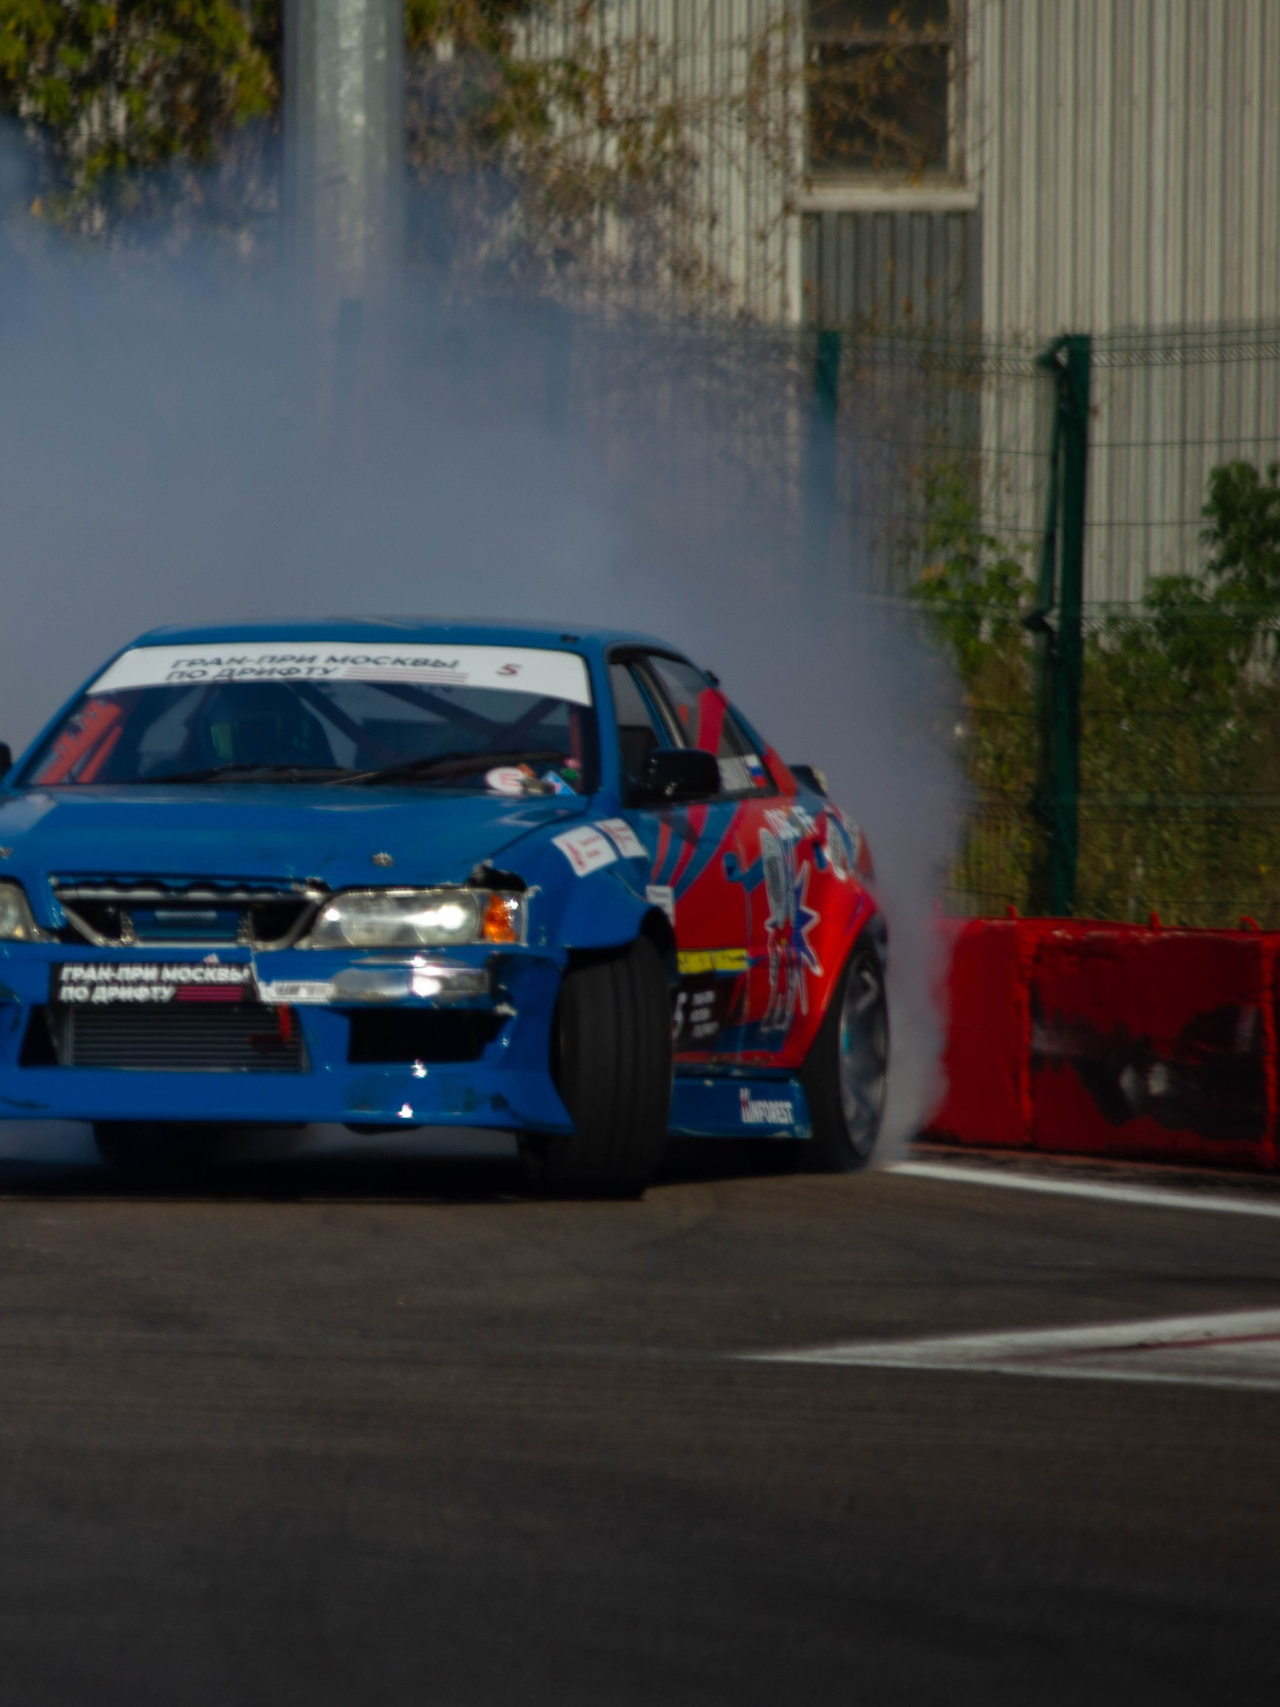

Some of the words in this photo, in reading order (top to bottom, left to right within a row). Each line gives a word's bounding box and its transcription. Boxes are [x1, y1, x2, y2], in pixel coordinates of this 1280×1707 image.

[172, 655, 317, 668] ГРАН-ПРИ
[325, 655, 460, 669] МОСКВЫ
[166, 669, 208, 681] ПО
[214, 667, 338, 682] ДРИФТУ
[60, 964, 160, 982] ГРАН-ПРИ
[161, 965, 252, 984] МОСКВЫ
[60, 984, 90, 1003] ПО
[91, 984, 178, 1004] ДРИФТУ
